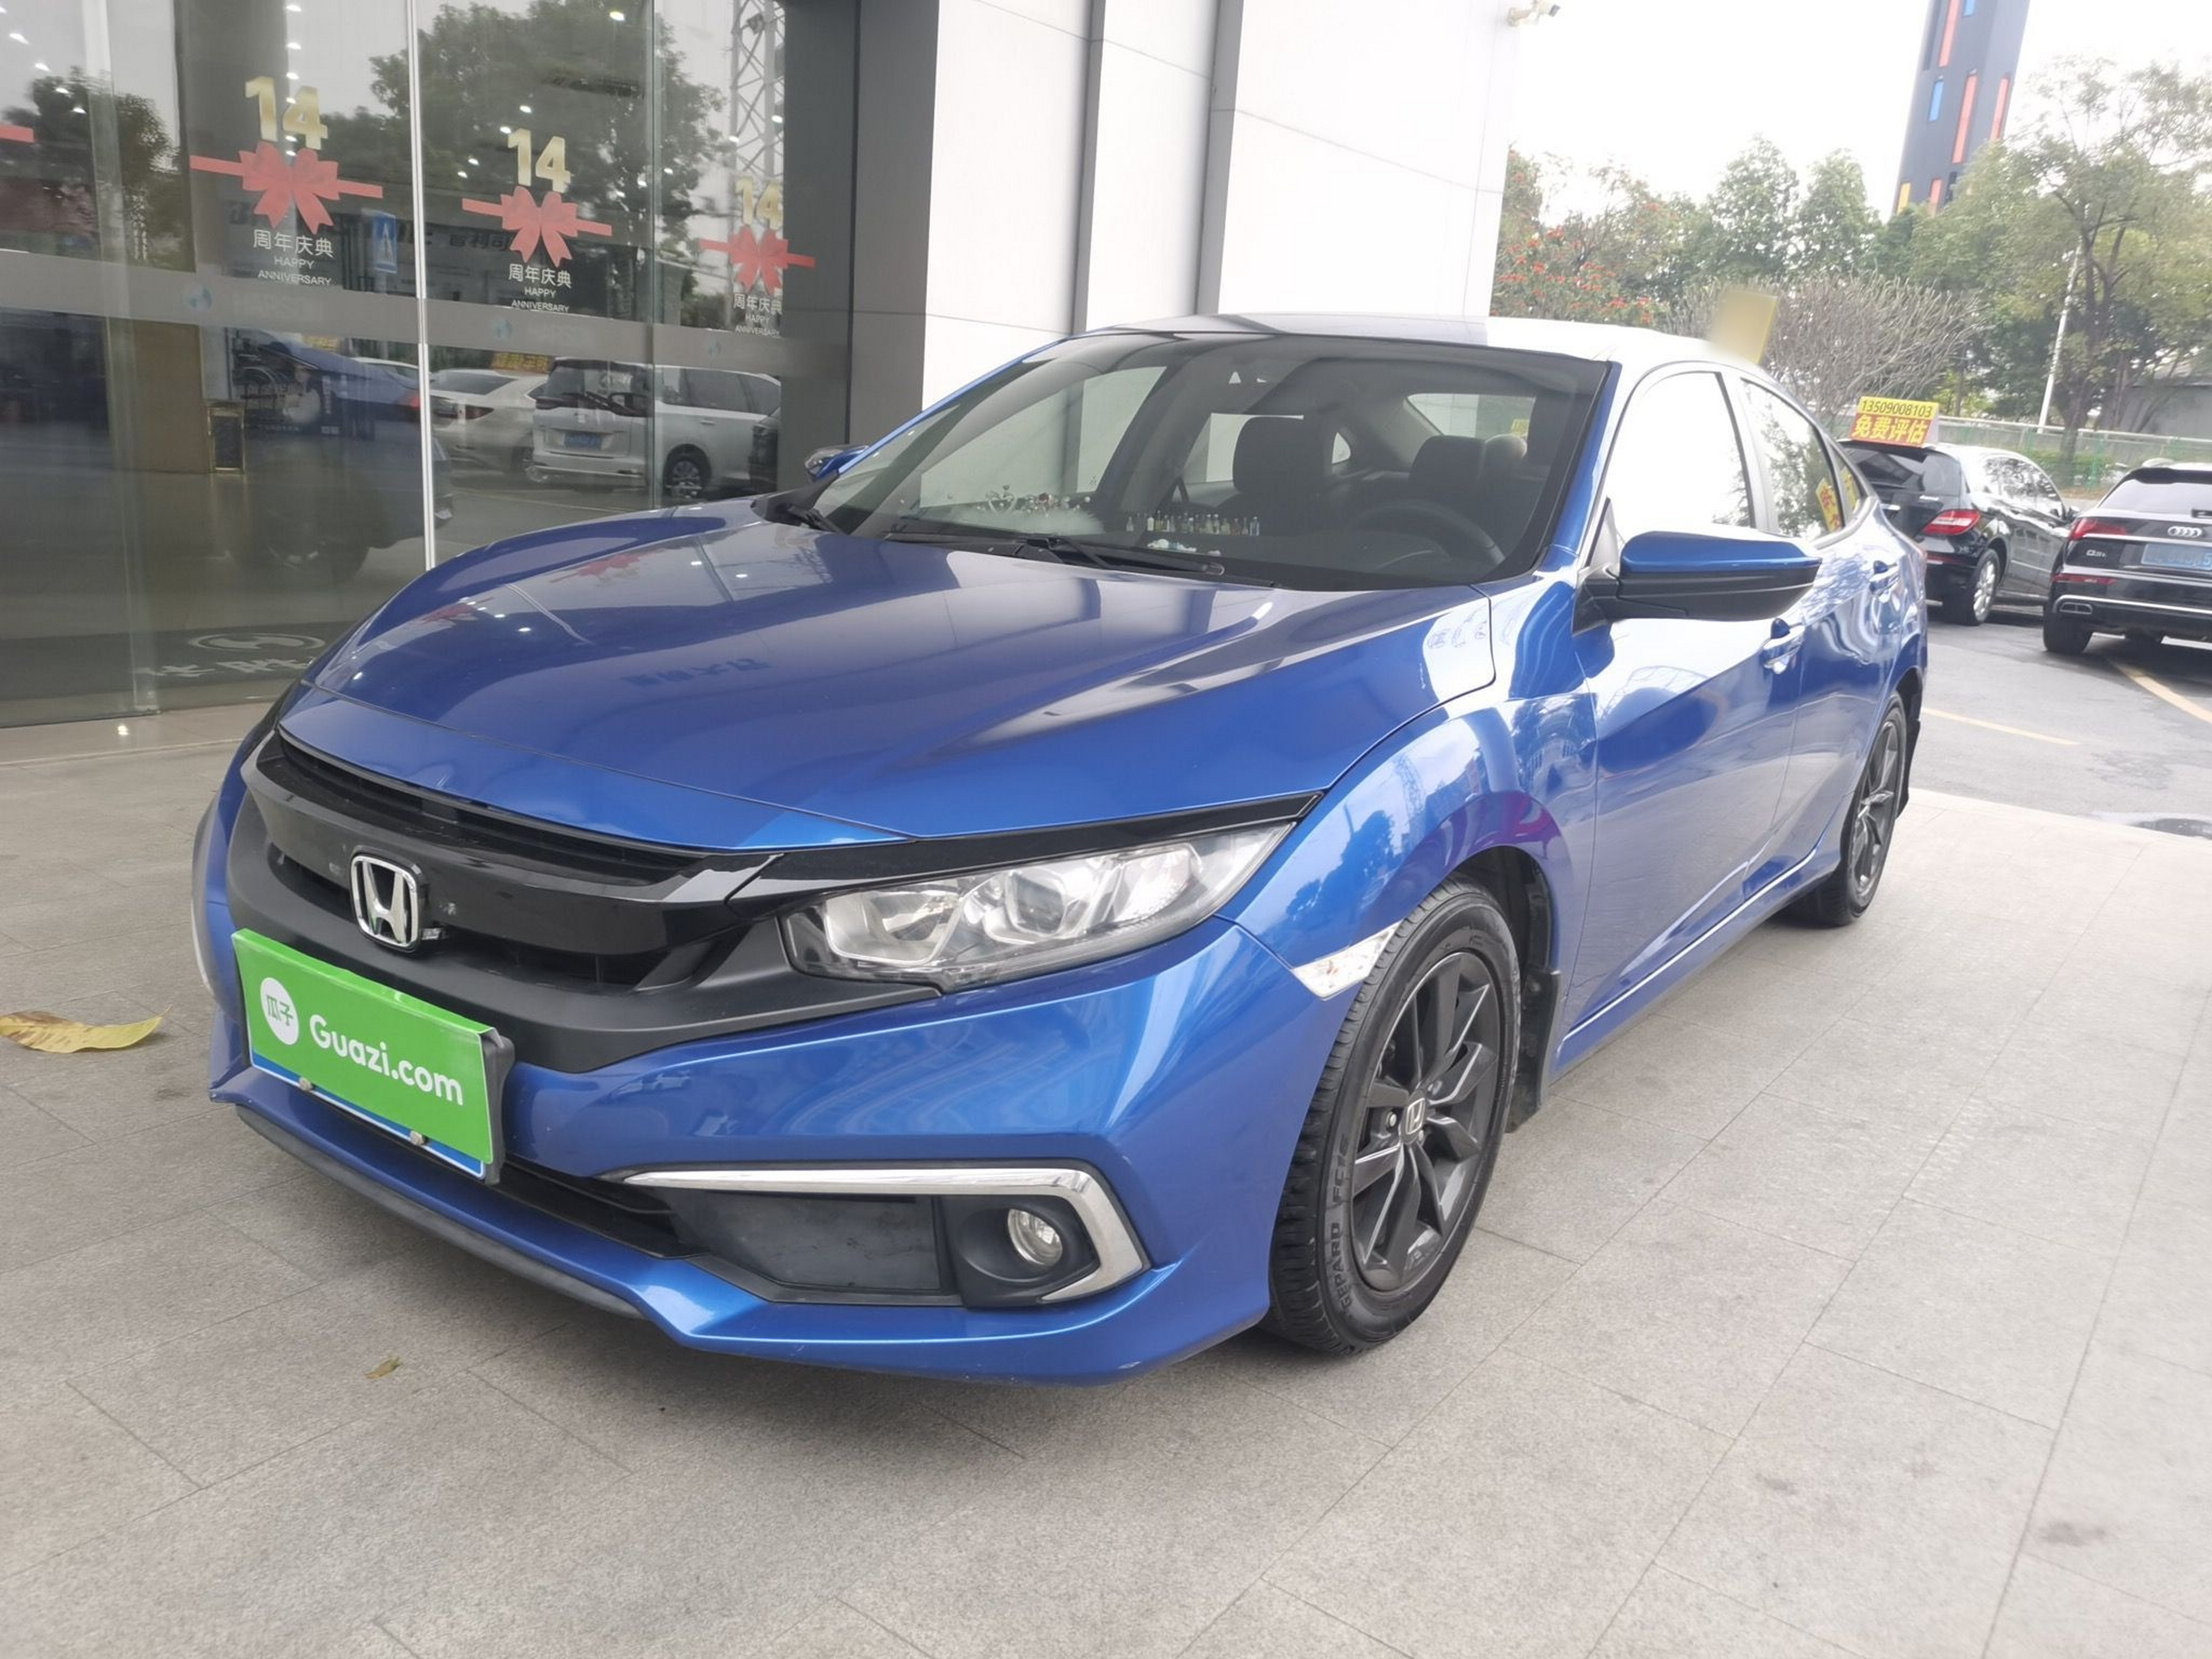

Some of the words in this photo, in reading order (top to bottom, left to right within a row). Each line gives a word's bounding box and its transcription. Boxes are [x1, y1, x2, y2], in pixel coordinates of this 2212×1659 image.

[245, 76, 328, 150] 14
[507, 128, 571, 193] 14
[736, 175, 783, 230] 14
[253, 229, 334, 259] 周年庆典
[274, 256, 315, 269] HAPPY
[508, 263, 571, 289] 周年庆典
[257, 269, 332, 286] ANNIVERSARY
[512, 300, 570, 313] ANNIVERSARY
[524, 287, 556, 298] HAPPY
[733, 293, 782, 315] 周年庆典
[1862, 400, 1933, 417] 13509008103
[1851, 414, 1927, 445] 免费评估
[266, 994, 293, 1027] 瓜子
[309, 1014, 464, 1106] Guazi.com
